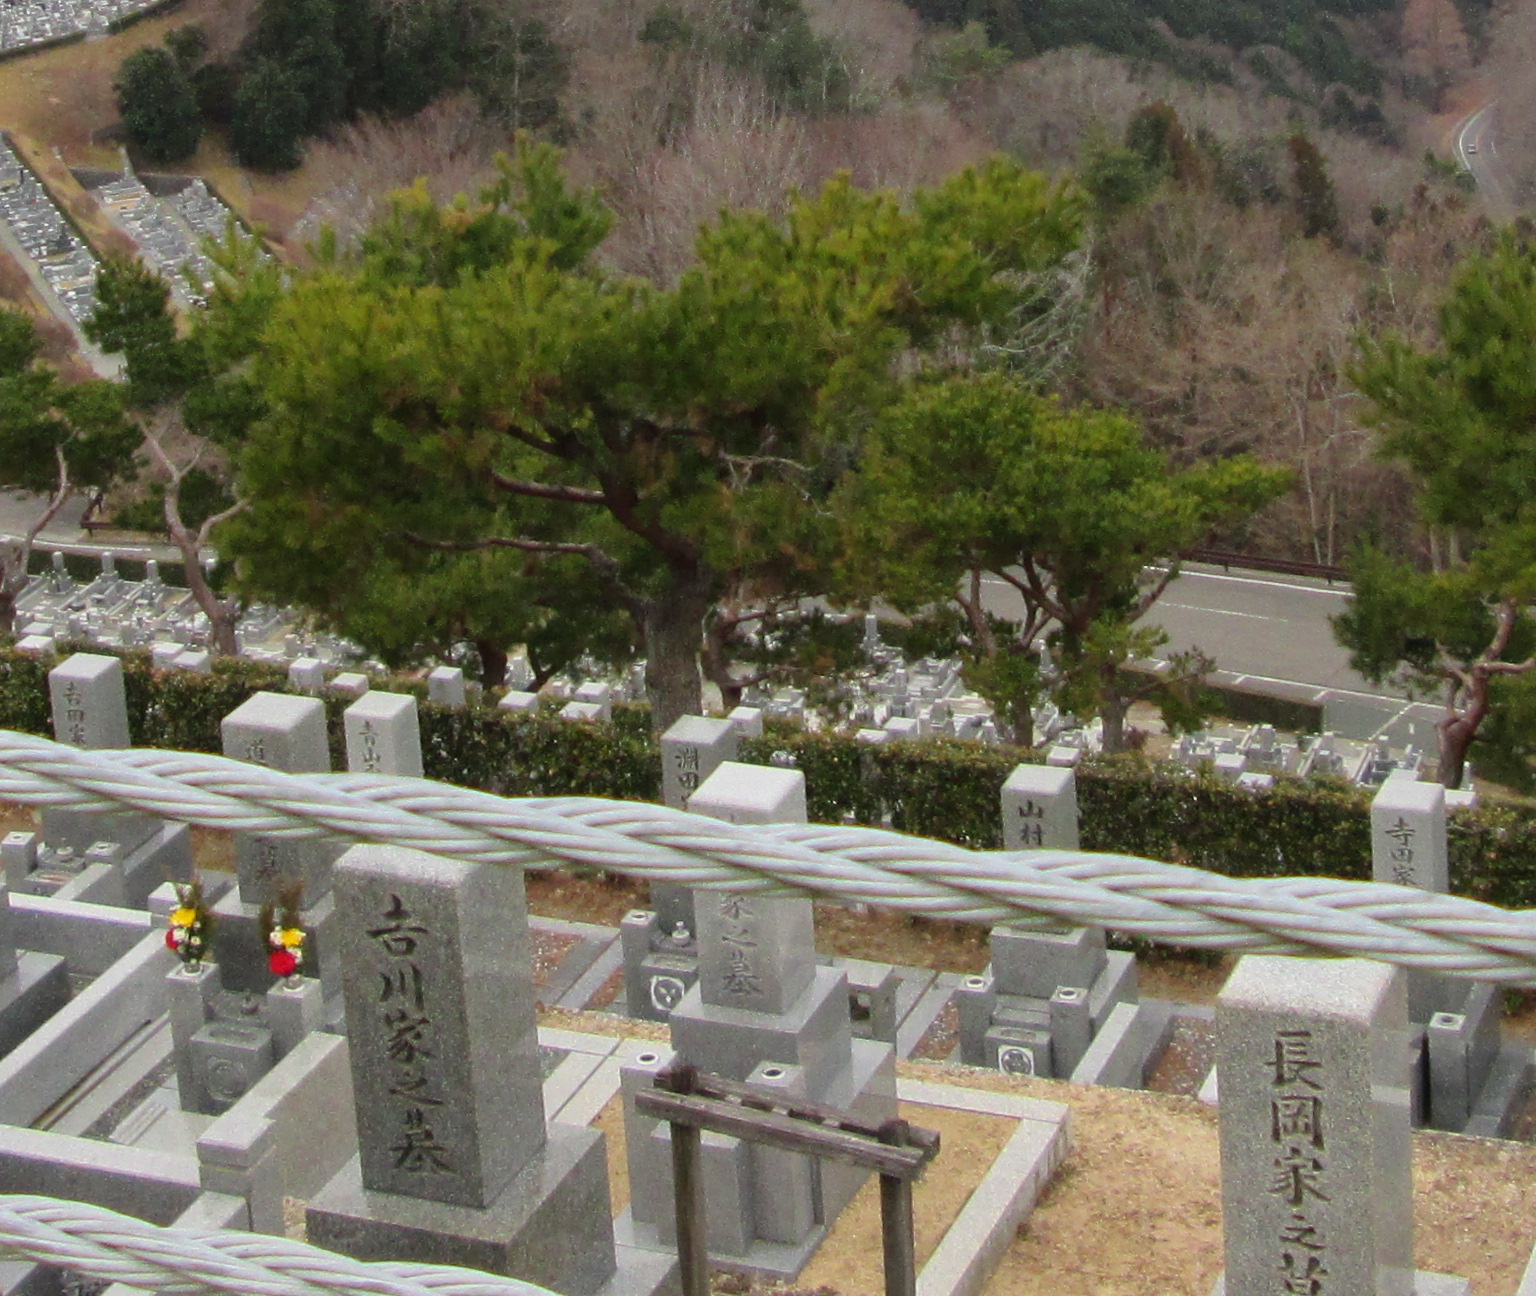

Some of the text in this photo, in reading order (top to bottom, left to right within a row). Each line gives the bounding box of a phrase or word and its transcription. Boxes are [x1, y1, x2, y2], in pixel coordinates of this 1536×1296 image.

[1018, 799, 1046, 846] 山村
[1384, 816, 1418, 885] 寺田家
[365, 892, 458, 1174] 吉川家之墓
